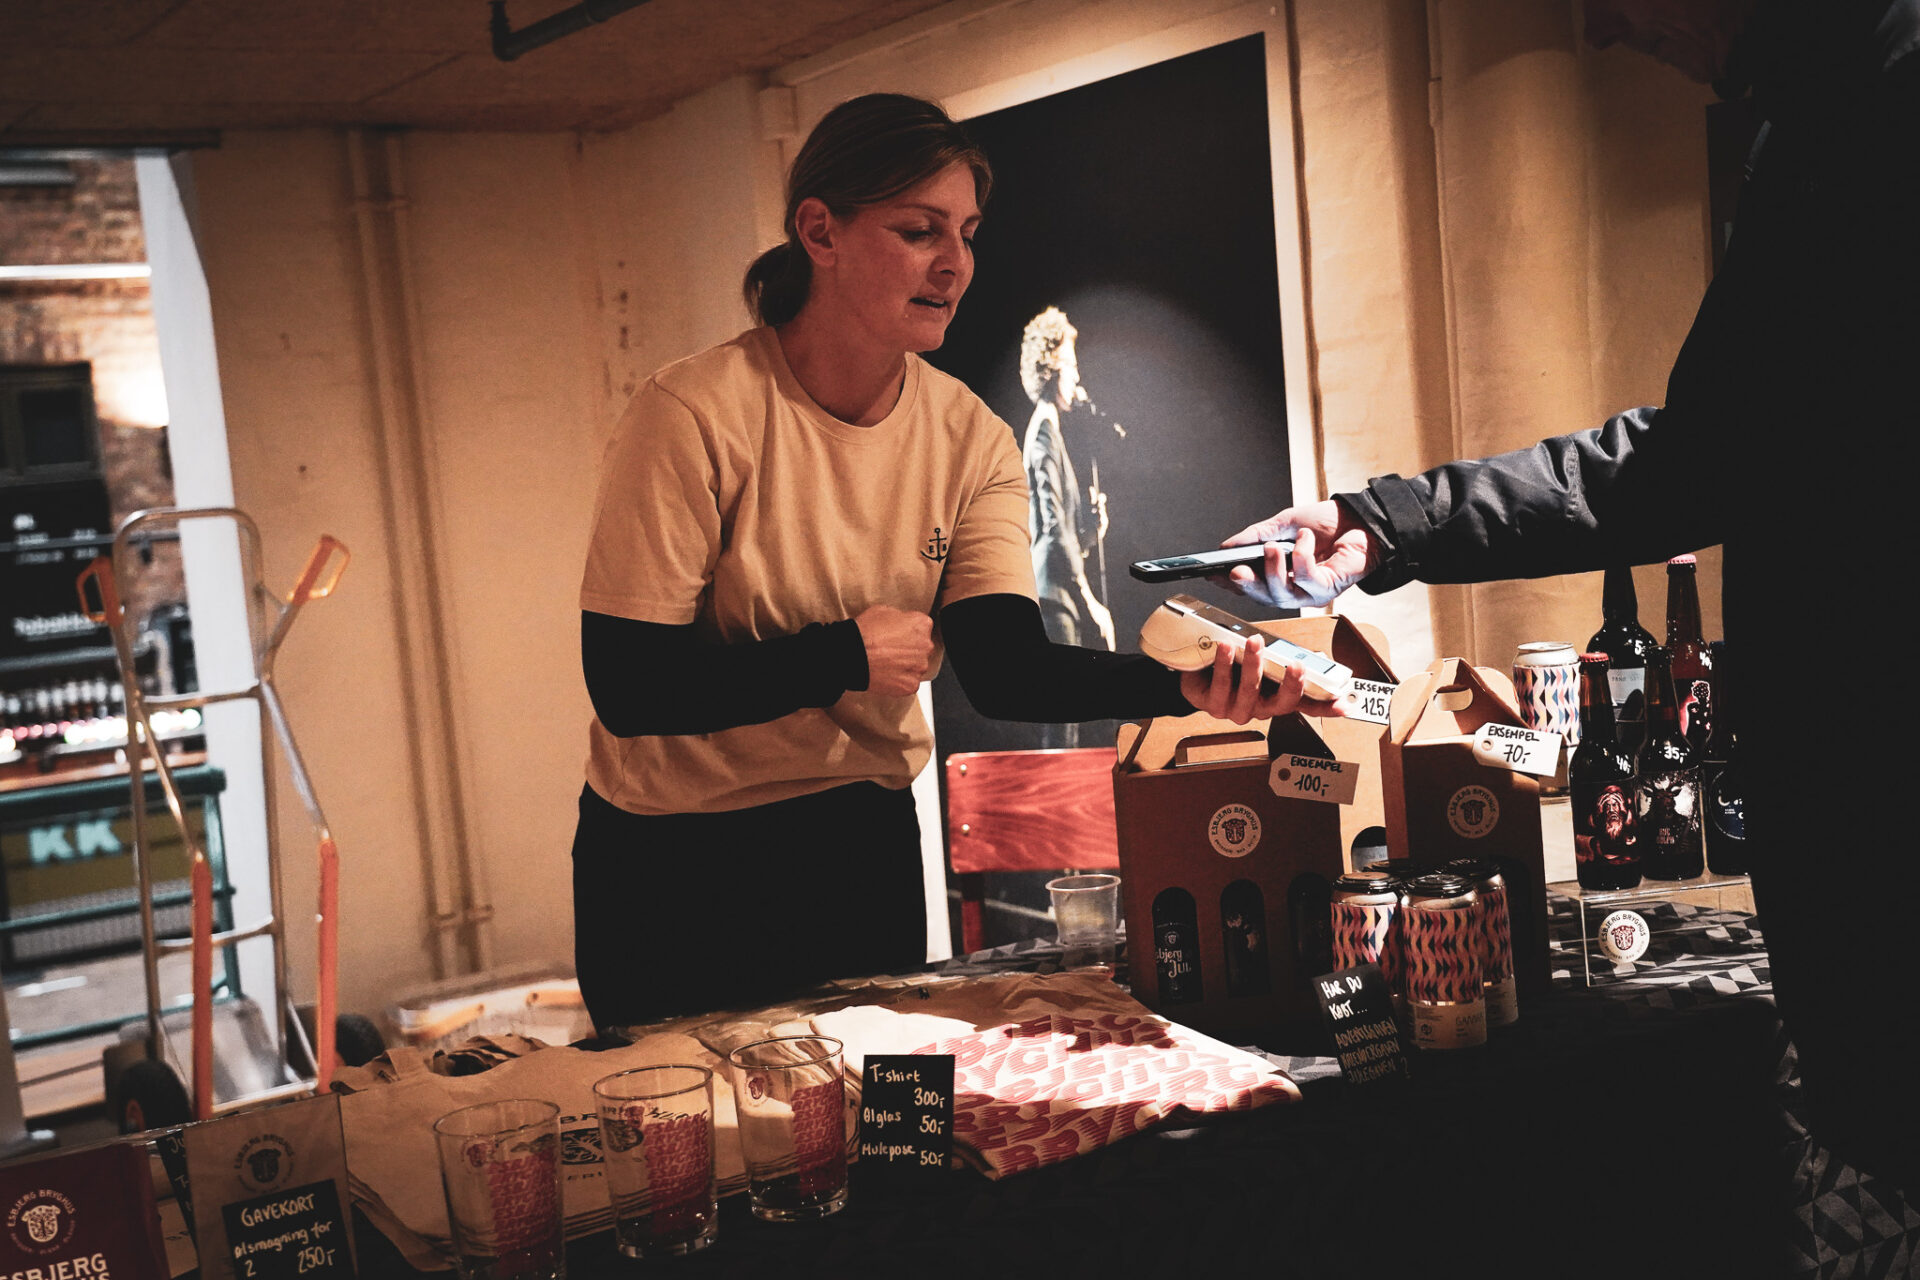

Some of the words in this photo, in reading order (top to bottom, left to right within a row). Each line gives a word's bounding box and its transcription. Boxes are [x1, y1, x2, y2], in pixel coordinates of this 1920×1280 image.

[1488, 725, 1540, 742] EKSEMPEL
[1290, 756, 1343, 773] EKSEMPEL
[1503, 743, 1531, 764] 70,-
[1294, 773, 1329, 796] 100,-
[1212, 808, 1231, 835] ESBJERG
[1234, 807, 1258, 831] BRYGHUS
[1320, 980, 1346, 999] HAR
[1345, 976, 1363, 994] DU
[869, 1063, 921, 1083] T-shirt
[913, 1086, 945, 1109] 300,-
[863, 1106, 902, 1129] Ølglas
[919, 1114, 945, 1135] 50,-
[861, 1141, 916, 1162] Mulepose
[919, 1150, 944, 1166] 50,-
[7, 1192, 37, 1228] ESBJERG
[39, 1189, 76, 1215] BRYGHUS
[241, 1193, 315, 1228] GAVEKORT
[244, 1259, 257, 1278] 2
